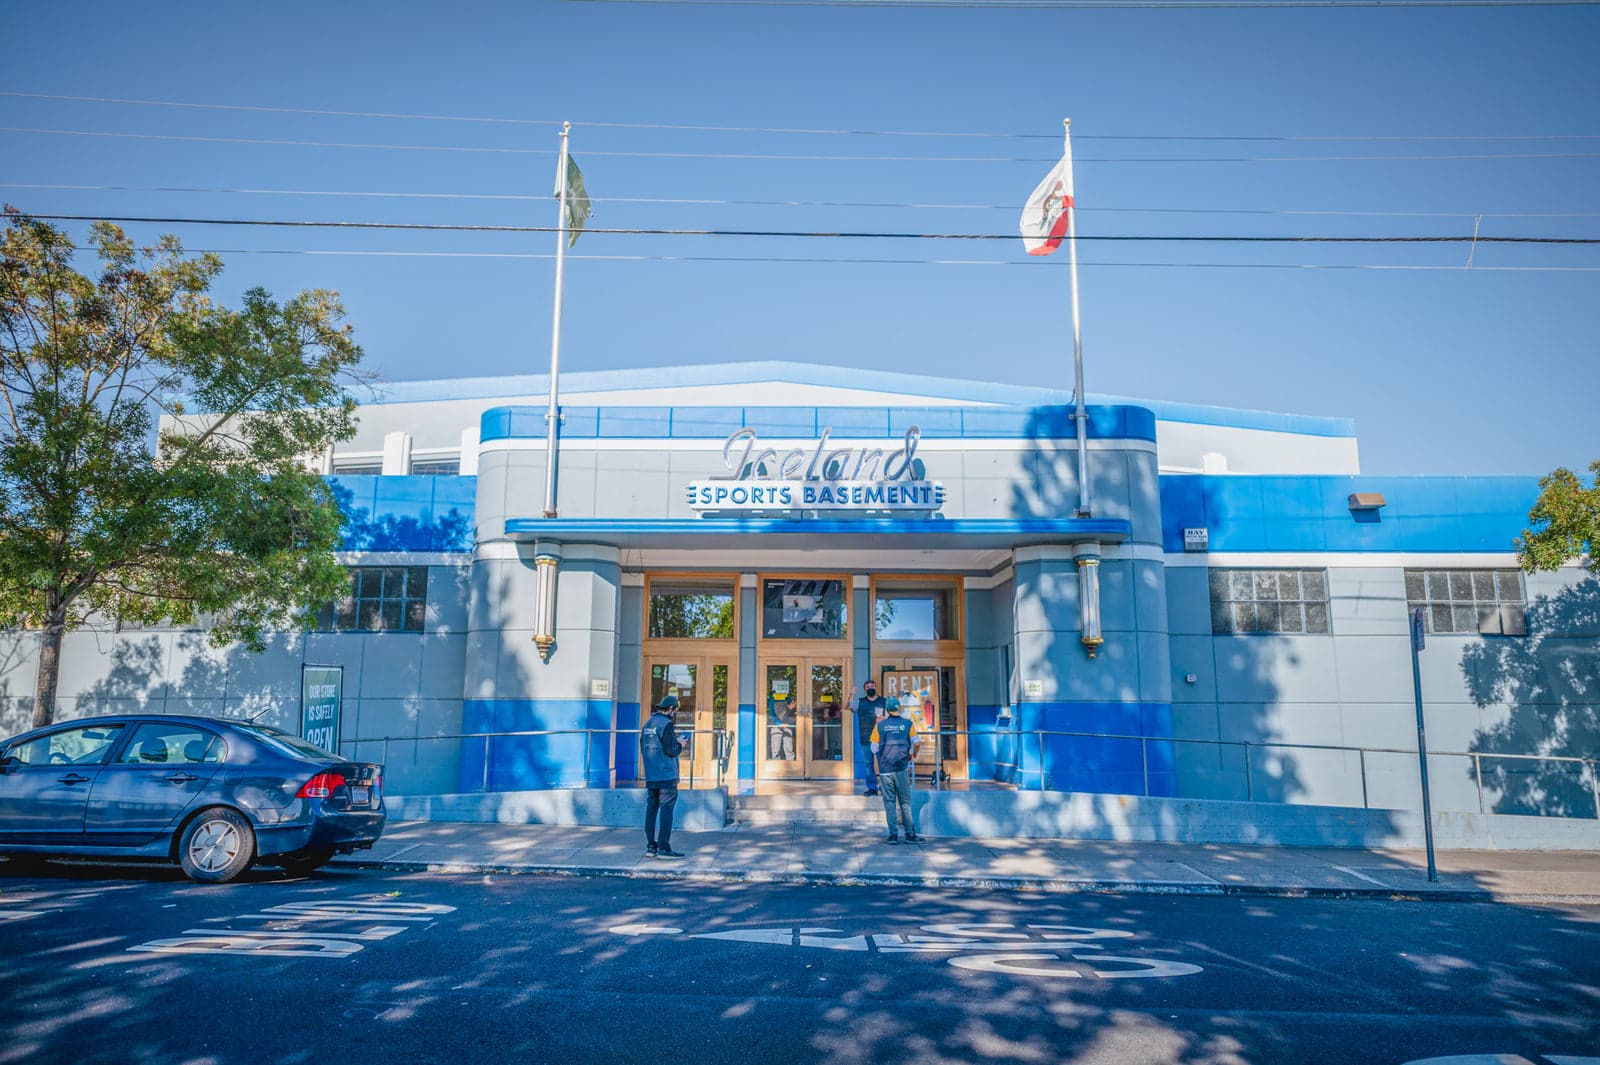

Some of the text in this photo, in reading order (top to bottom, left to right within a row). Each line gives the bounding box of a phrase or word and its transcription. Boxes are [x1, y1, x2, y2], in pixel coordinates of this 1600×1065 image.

[709, 426, 921, 480] Iceland
[700, 486, 931, 504] SPORTS BASEMENT
[321, 684, 335, 697] STORE
[888, 676, 934, 697] RENT
[309, 704, 334, 720] IS SAFELY
